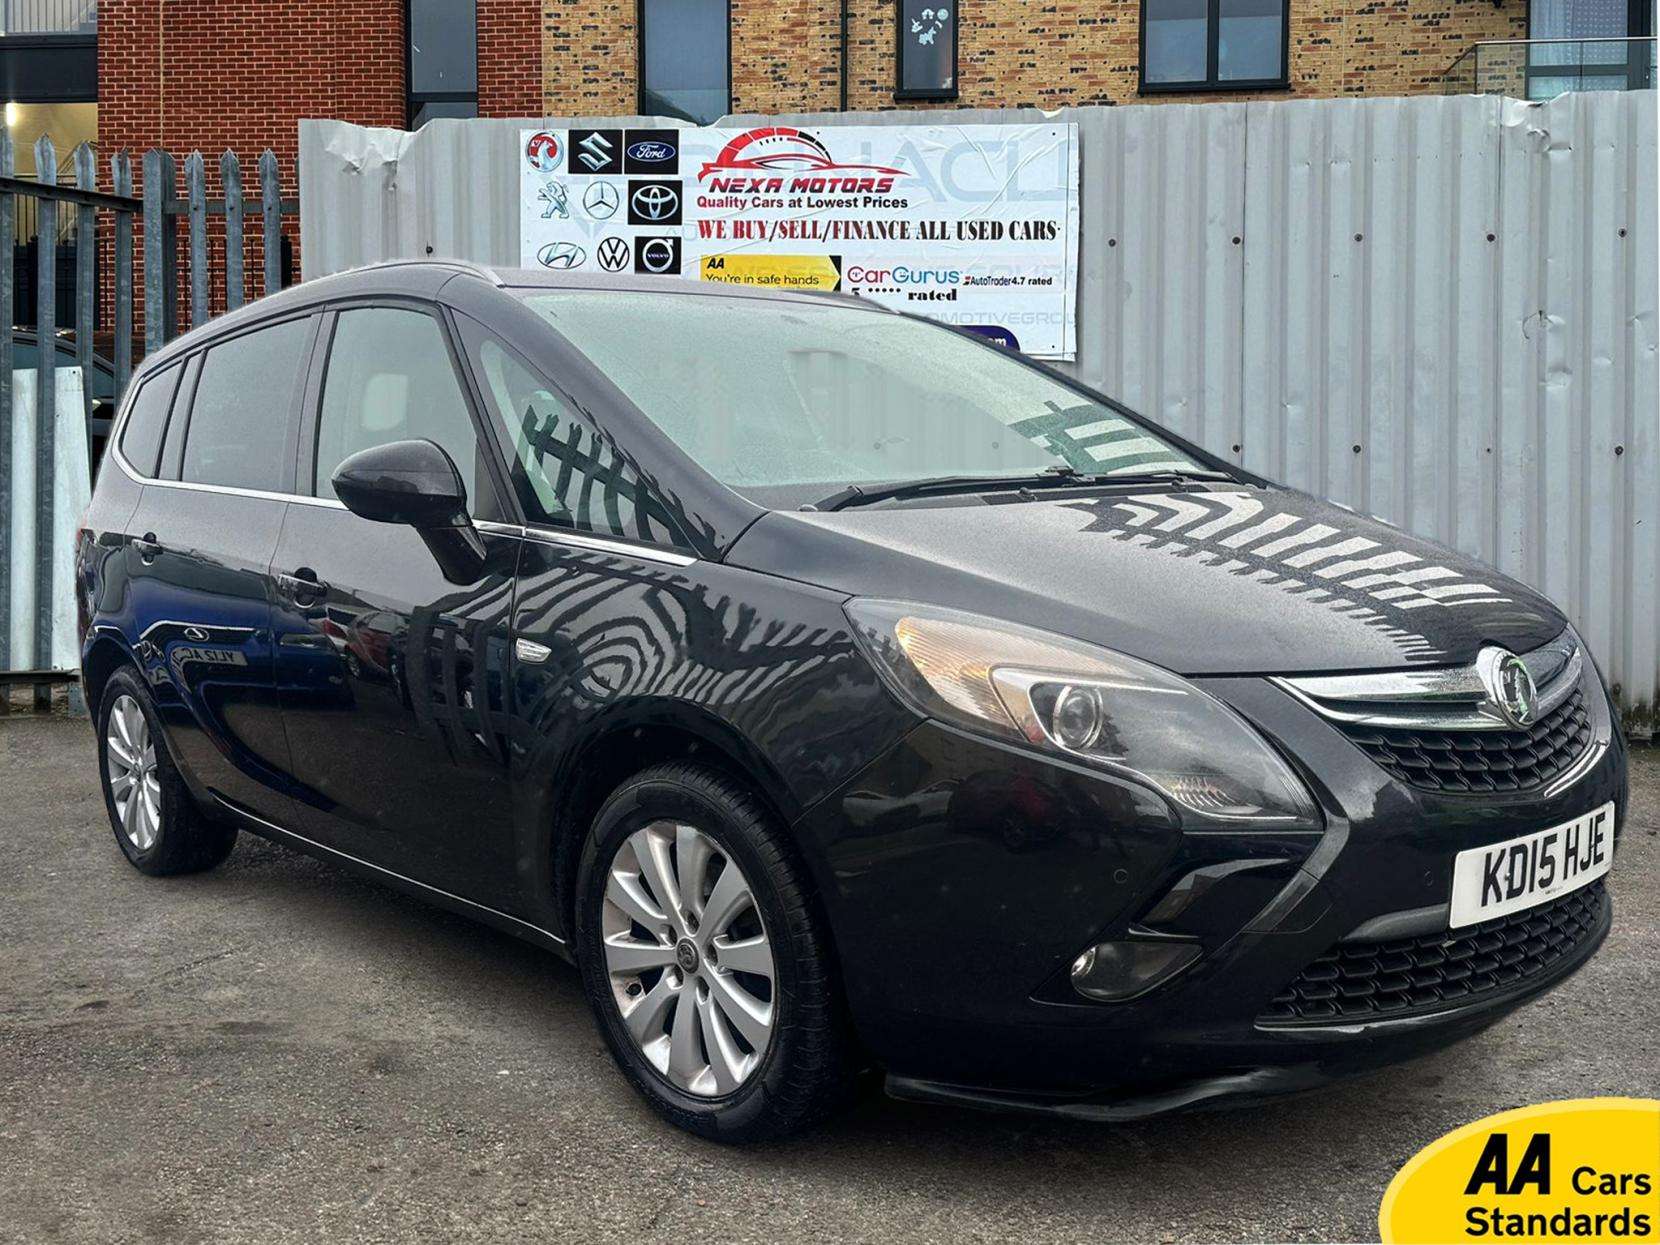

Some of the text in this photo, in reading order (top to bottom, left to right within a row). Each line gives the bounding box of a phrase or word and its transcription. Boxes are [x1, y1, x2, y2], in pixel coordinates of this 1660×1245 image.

[636, 144, 666, 158] Ford
[708, 178, 894, 193] NEXA MOTORS
[697, 196, 908, 210] Quality Cars at Lowest Prices
[697, 220, 726, 240] WE
[733, 220, 910, 242] BUY/SELL/FINANCE
[916, 220, 950, 240] ALL
[956, 220, 1003, 240] USED
[1008, 220, 1056, 240] CARS
[707, 258, 725, 269] AA
[706, 273, 819, 285] You're in safe hands
[847, 266, 960, 284] CarGurus
[1028, 277, 1052, 285] rated
[908, 288, 957, 301] rated
[1481, 812, 1606, 908] KD15 HJE
